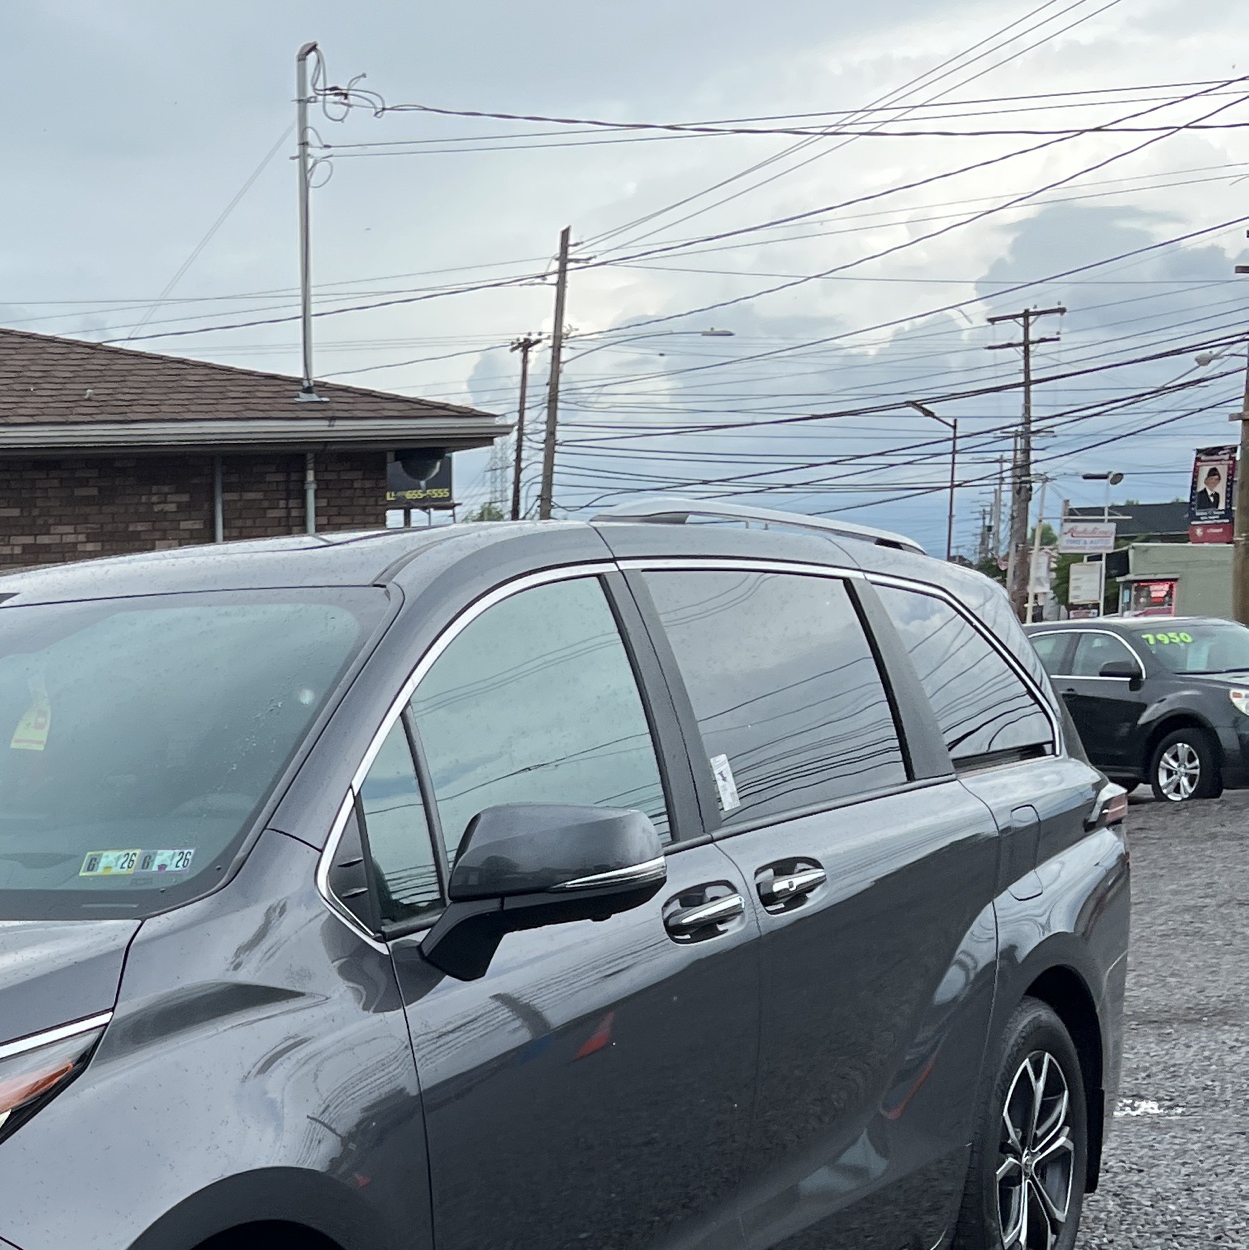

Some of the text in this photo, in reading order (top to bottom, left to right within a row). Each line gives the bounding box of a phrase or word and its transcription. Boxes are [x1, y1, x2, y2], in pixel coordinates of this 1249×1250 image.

[1141, 632, 1193, 645] 7950
[120, 853, 137, 869] 26
[175, 851, 191, 868] 26
